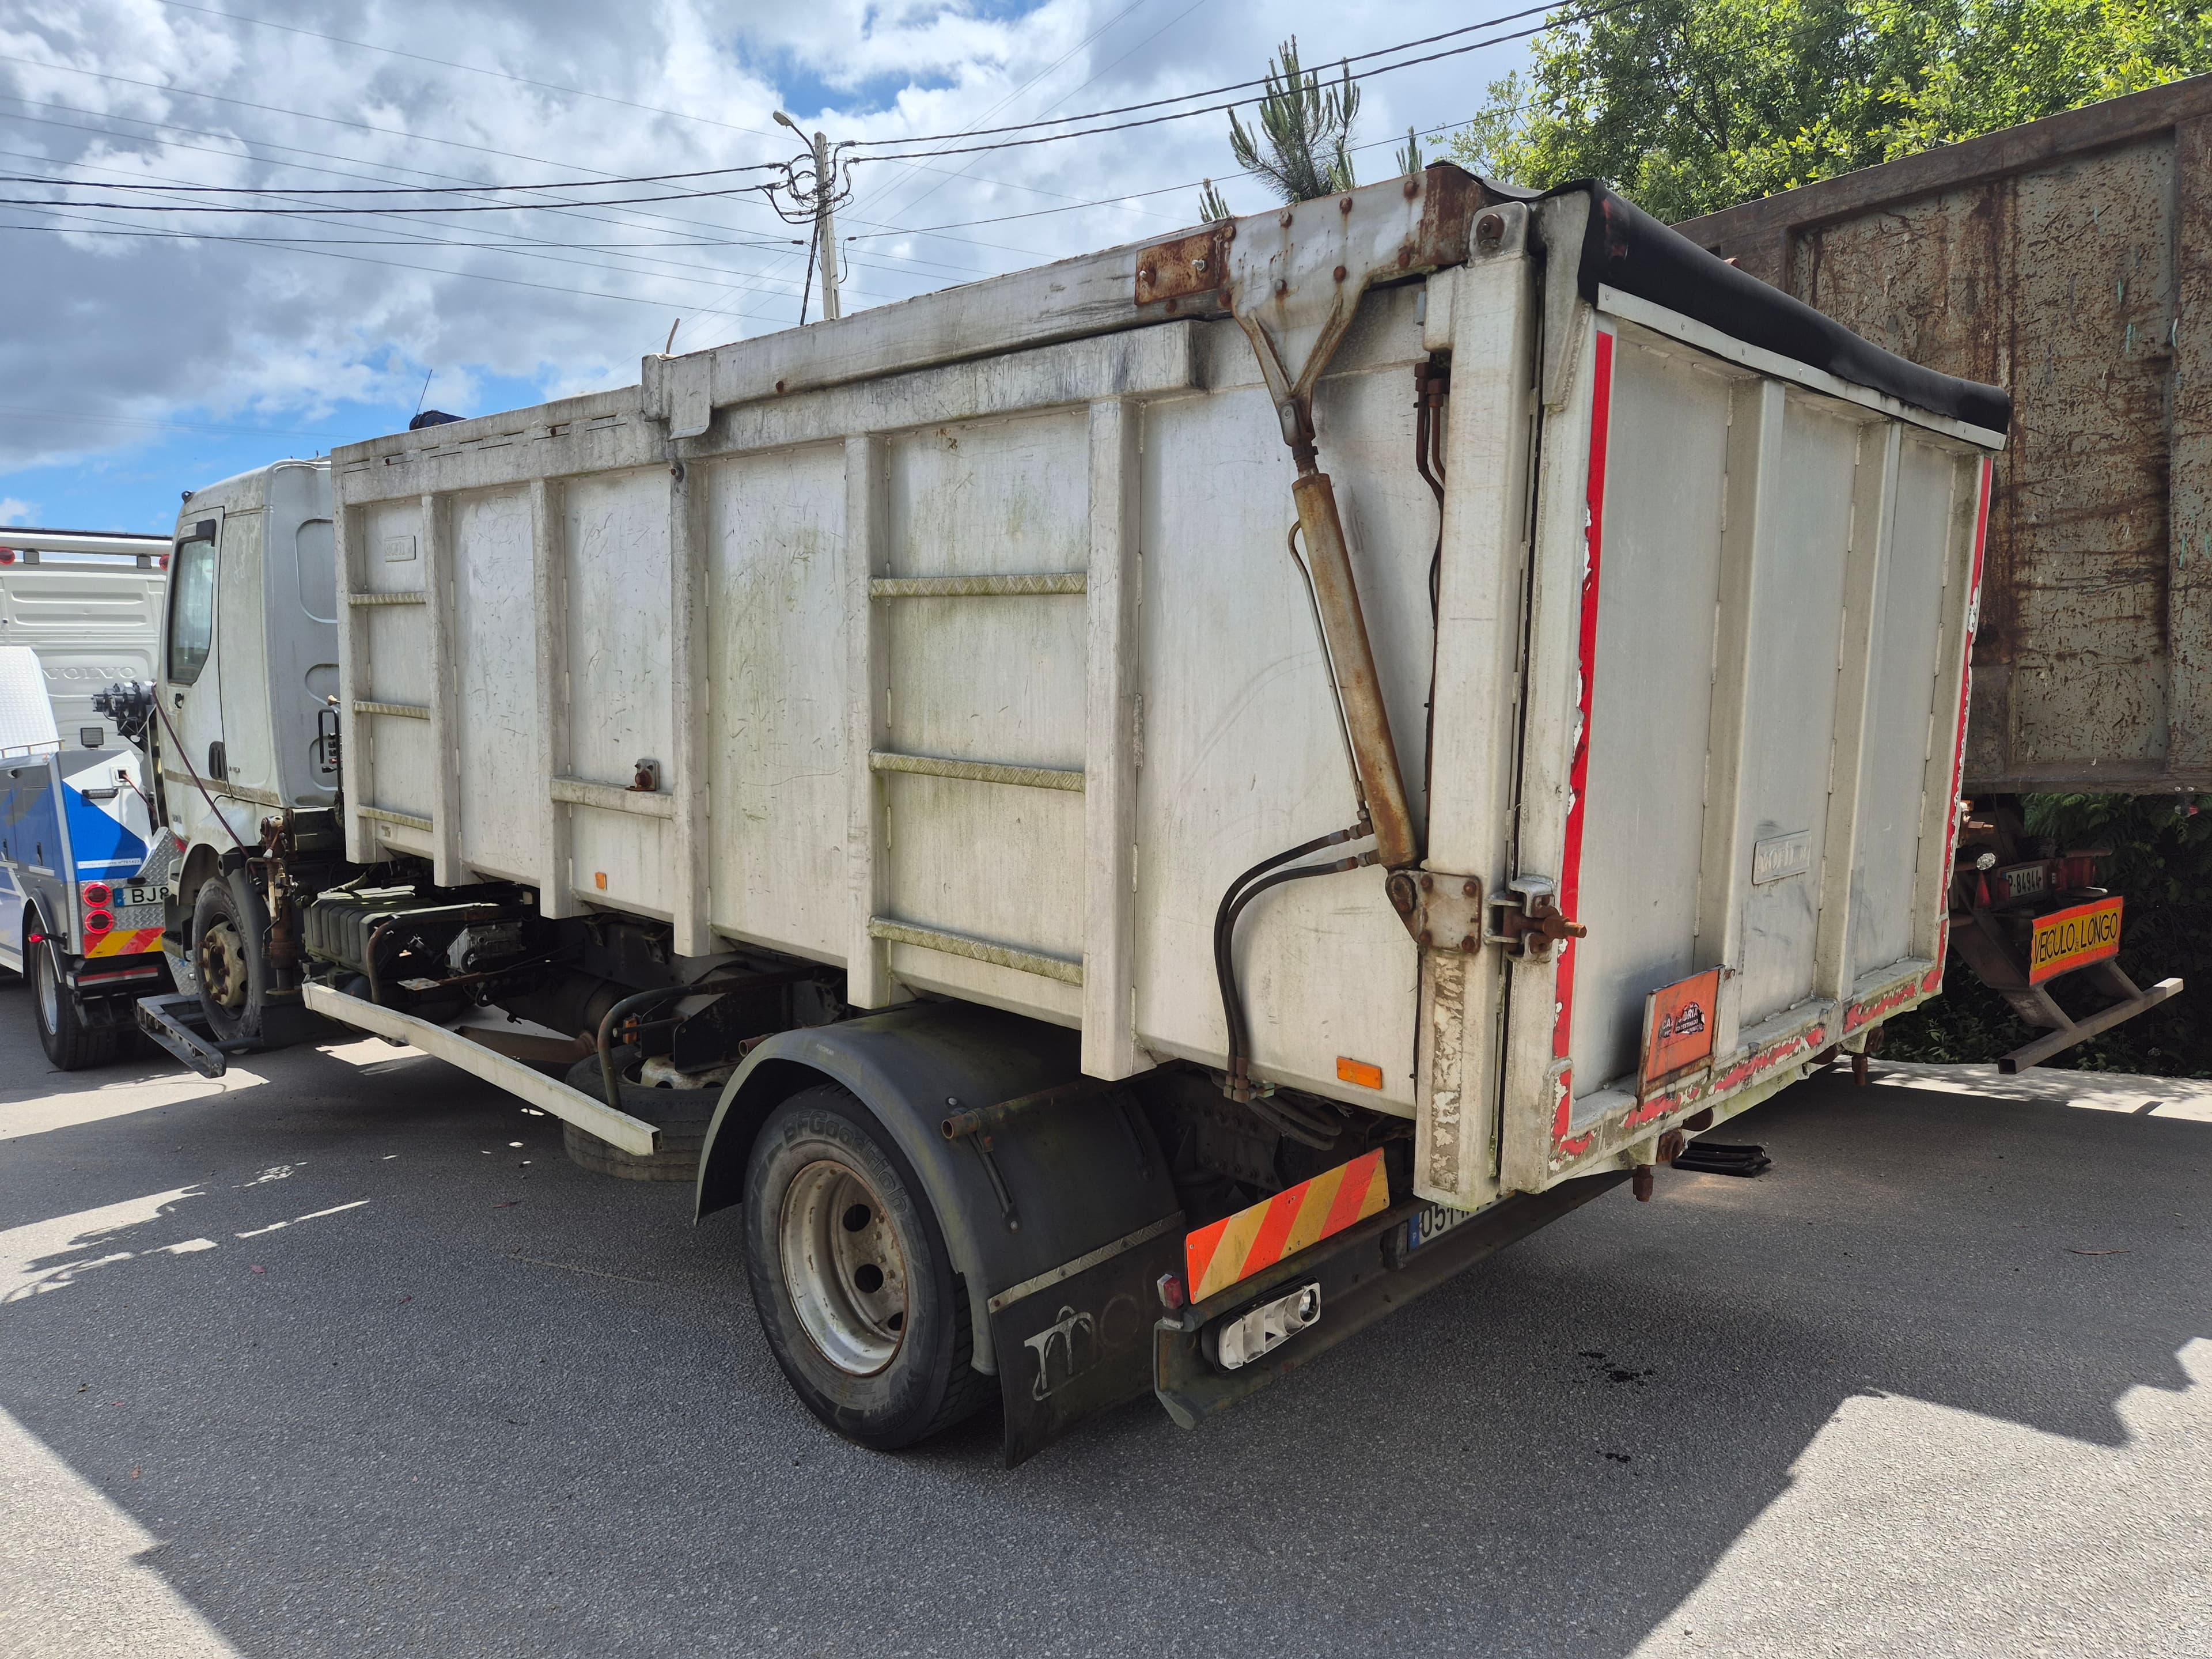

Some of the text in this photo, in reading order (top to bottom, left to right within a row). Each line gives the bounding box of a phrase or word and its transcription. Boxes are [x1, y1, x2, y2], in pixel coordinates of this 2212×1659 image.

[42, 666, 137, 680] VOLVO
[2081, 912, 2118, 948] LONGO
[783, 1109, 908, 1213] BFGoodrich
